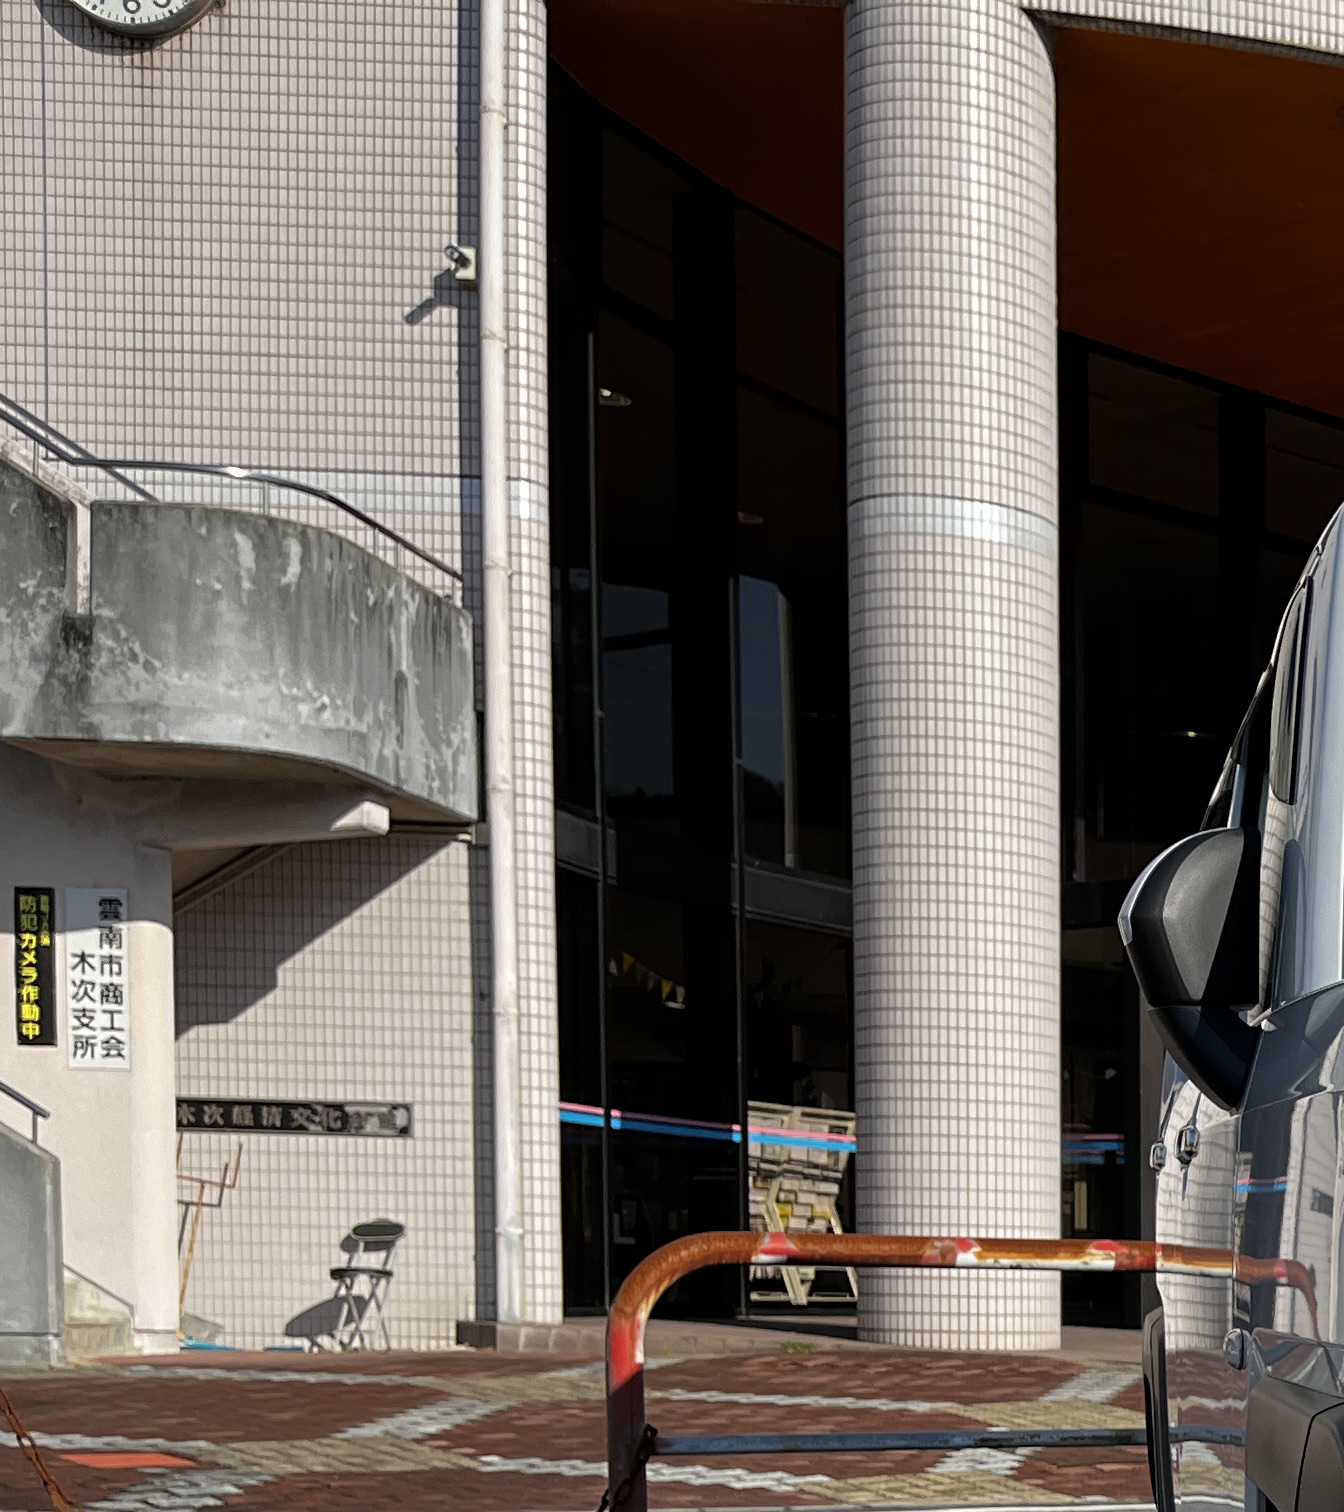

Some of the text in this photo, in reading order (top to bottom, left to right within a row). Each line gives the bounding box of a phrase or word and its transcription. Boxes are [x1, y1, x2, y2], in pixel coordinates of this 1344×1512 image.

[19, 894, 41, 1040] 防犯カメラ作動中
[71, 950, 97, 1060] 木次支所
[99, 896, 126, 1060] 雲南市商工会
